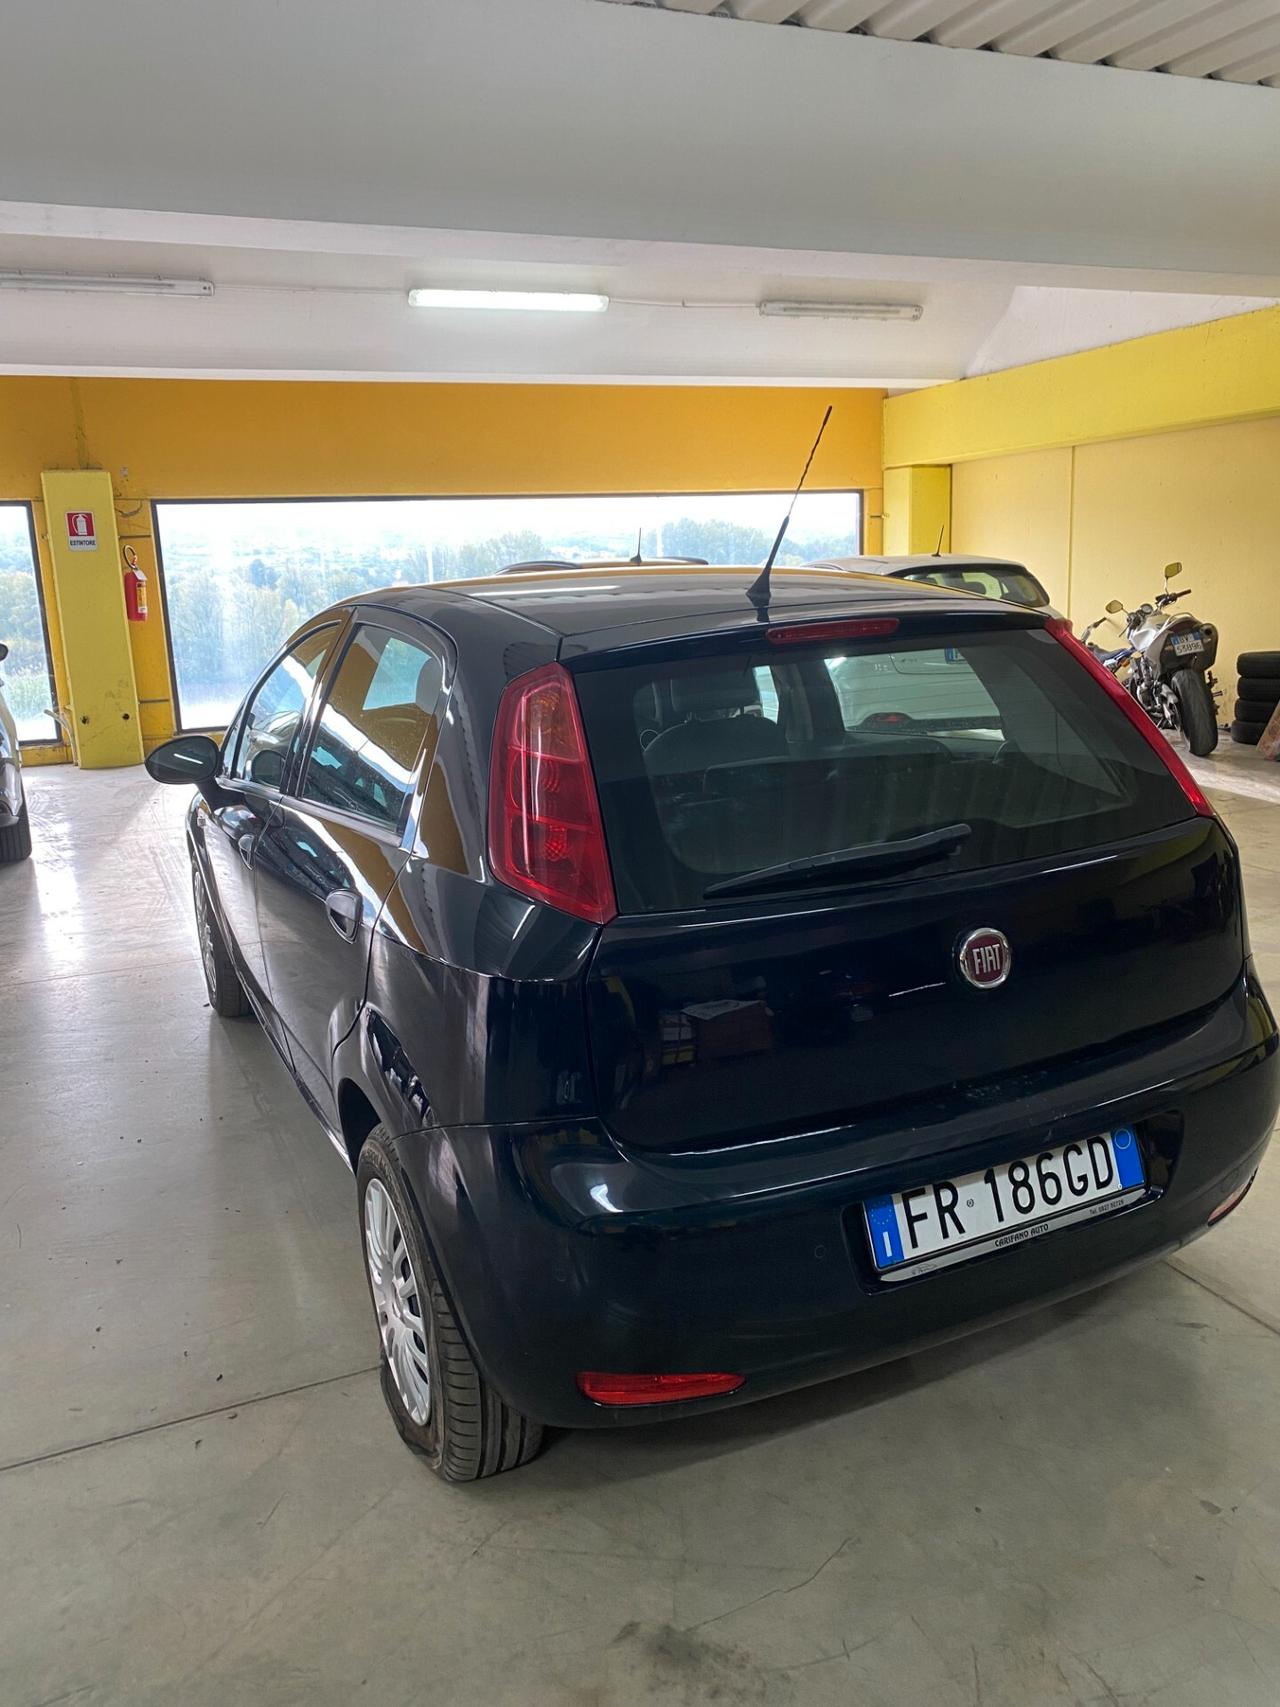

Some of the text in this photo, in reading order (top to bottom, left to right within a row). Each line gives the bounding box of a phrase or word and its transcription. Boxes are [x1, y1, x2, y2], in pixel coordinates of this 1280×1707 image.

[972, 943, 1000, 975] FIAT
[900, 1180, 966, 1249] FR
[983, 1136, 1115, 1223] 186GD
[994, 1223, 1049, 1247] CARIFANO AUTO
